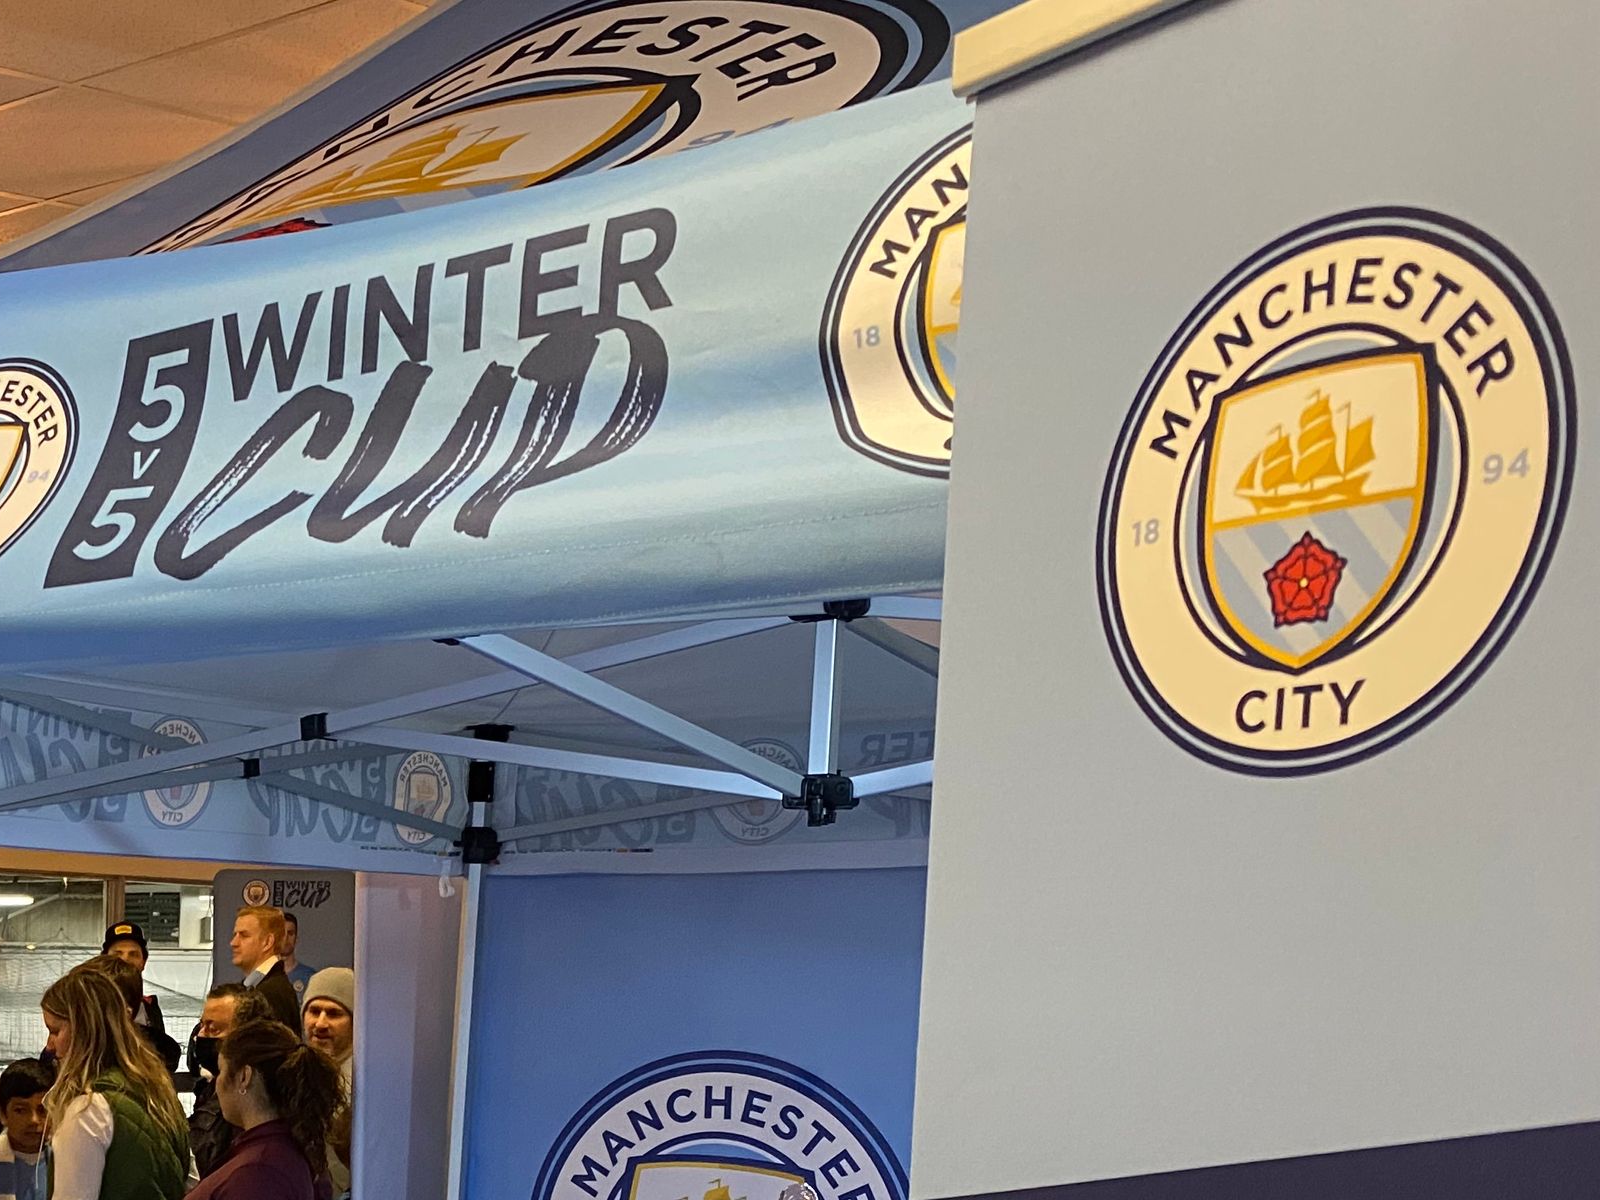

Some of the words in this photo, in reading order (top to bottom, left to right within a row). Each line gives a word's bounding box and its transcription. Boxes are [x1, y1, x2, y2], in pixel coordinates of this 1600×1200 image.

[222, 208, 679, 402] WINTER
[853, 326, 880, 348] 18
[1148, 256, 1516, 459] MANCHESTER
[155, 313, 671, 581] CUP
[26, 468, 51, 485] 94
[1481, 448, 1531, 484] 94
[1131, 519, 1160, 546] 18
[1234, 678, 1366, 734] CITY
[284, 888, 331, 909] CUP
[285, 880, 331, 890] WINTER
